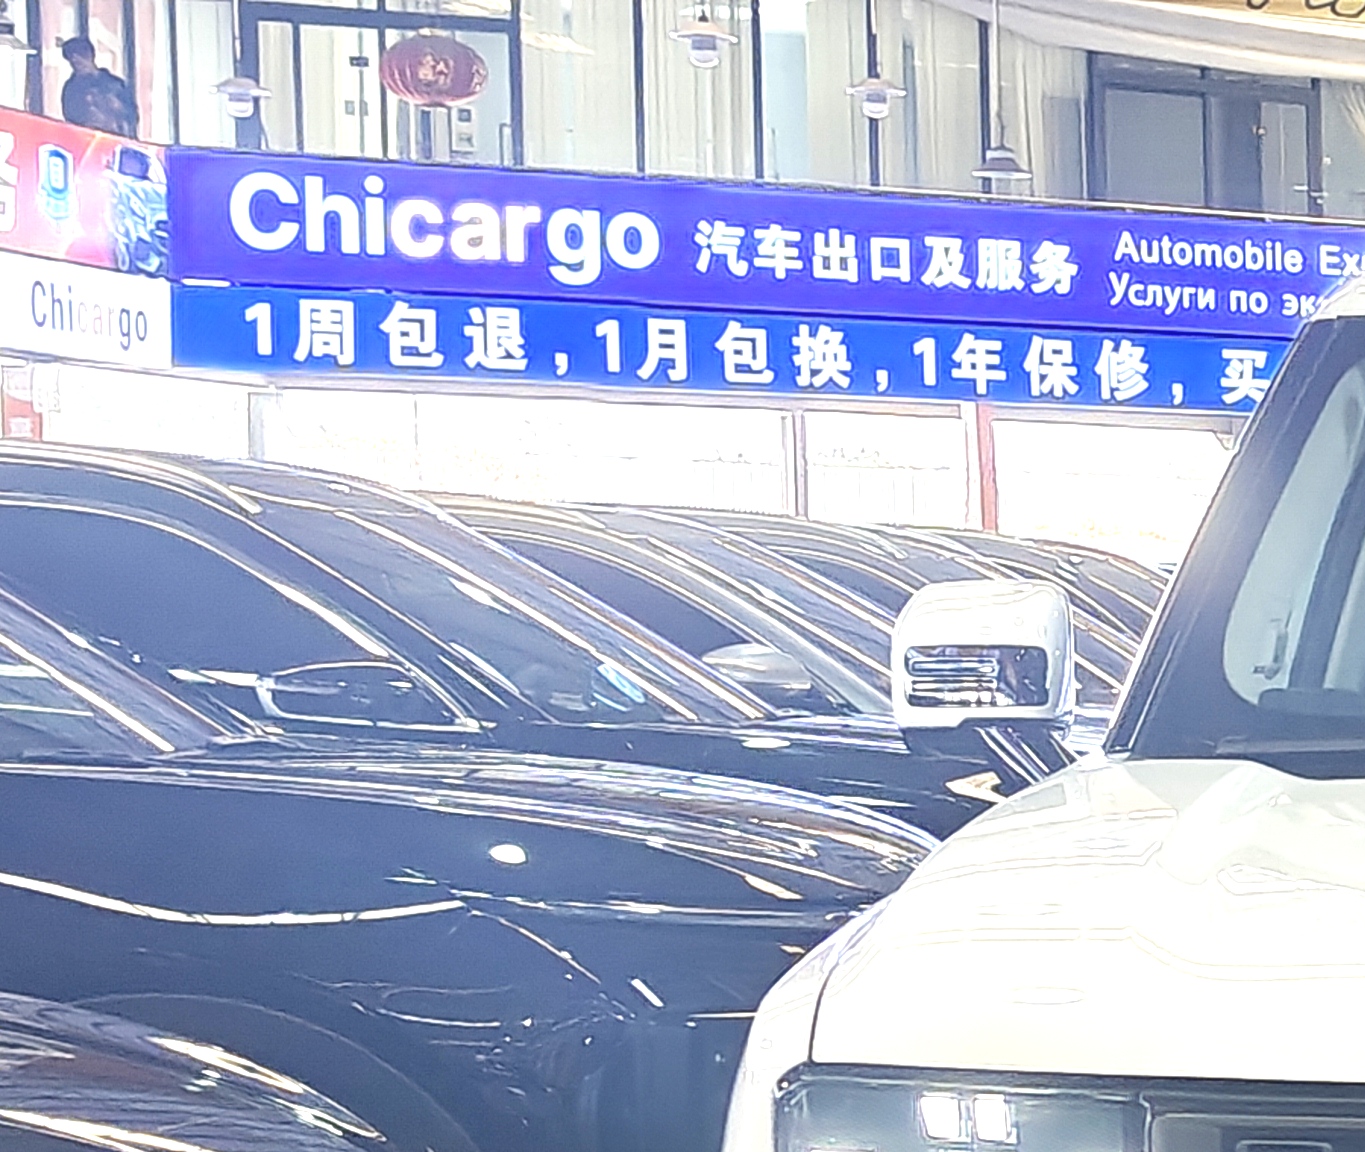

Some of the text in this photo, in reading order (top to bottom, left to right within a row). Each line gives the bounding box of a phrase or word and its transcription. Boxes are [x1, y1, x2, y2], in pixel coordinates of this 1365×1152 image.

[229, 171, 660, 286] Chicargo
[694, 219, 1080, 295] 汽车出口及服务
[1114, 230, 1304, 274] Automobile
[31, 280, 148, 351] Chicargo
[1108, 270, 1325, 317] Услуги по эк
